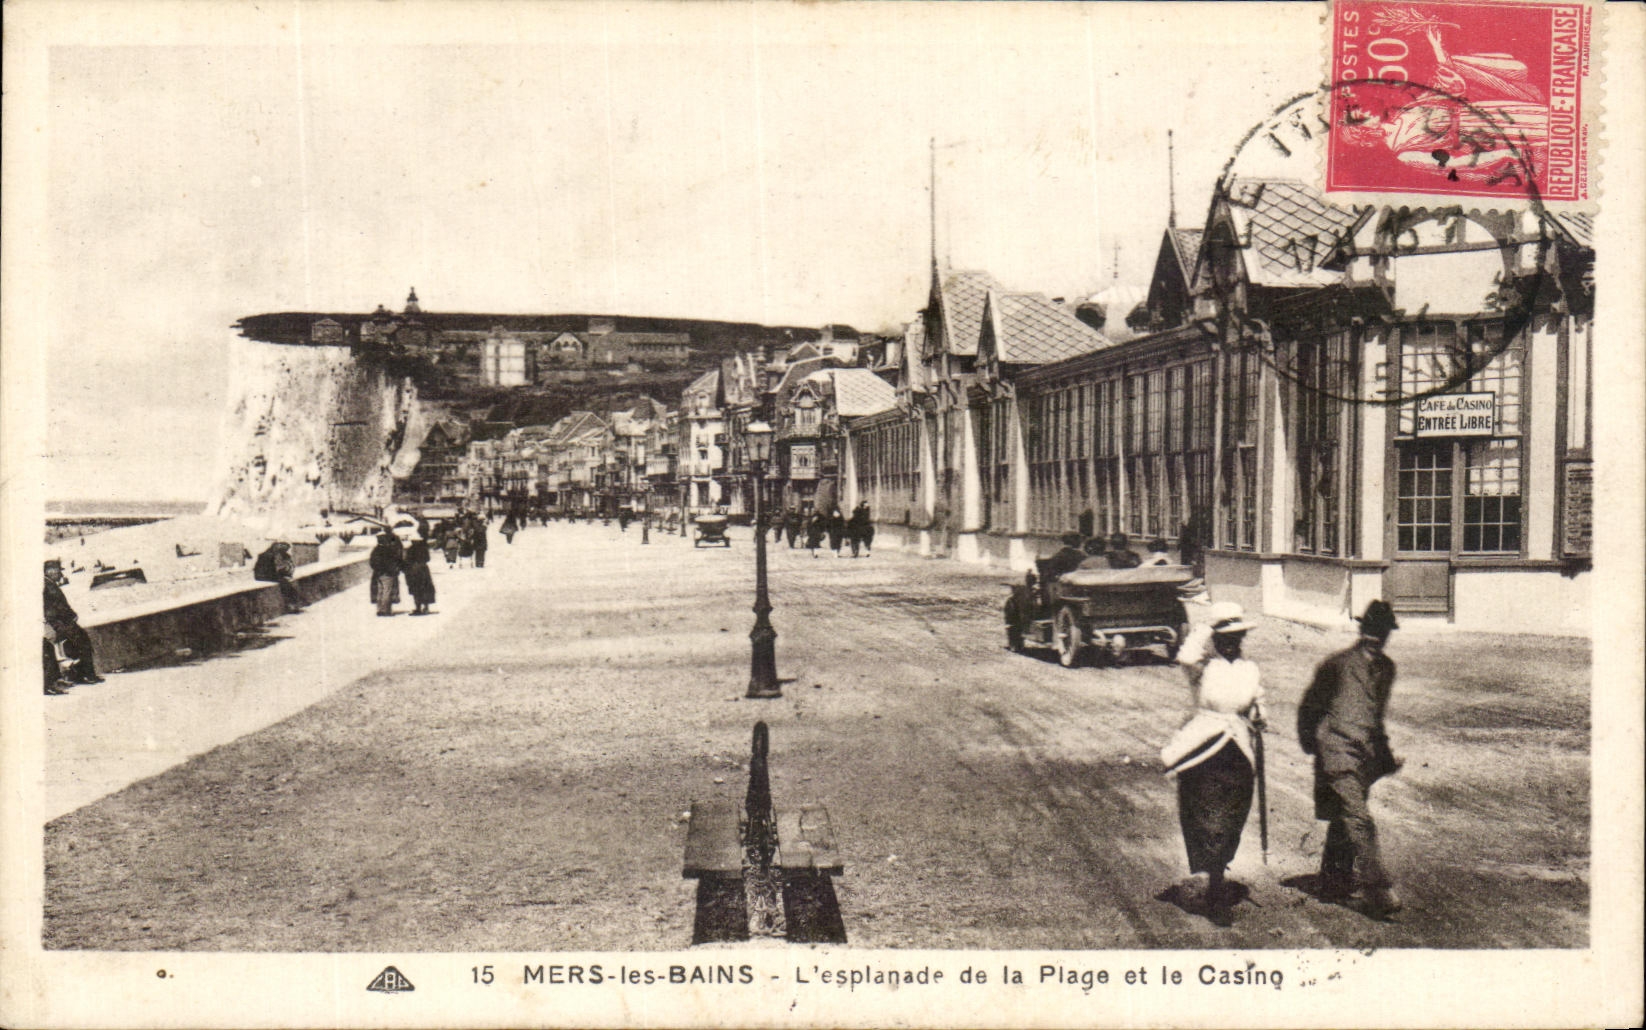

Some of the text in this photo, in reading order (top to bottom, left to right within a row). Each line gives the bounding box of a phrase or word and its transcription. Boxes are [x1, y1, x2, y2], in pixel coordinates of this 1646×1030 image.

[1341, 10, 1360, 98] POSTES
[1456, 397, 1492, 411] CASINO
[1418, 413, 1492, 431] ENTRÉE LIBRE
